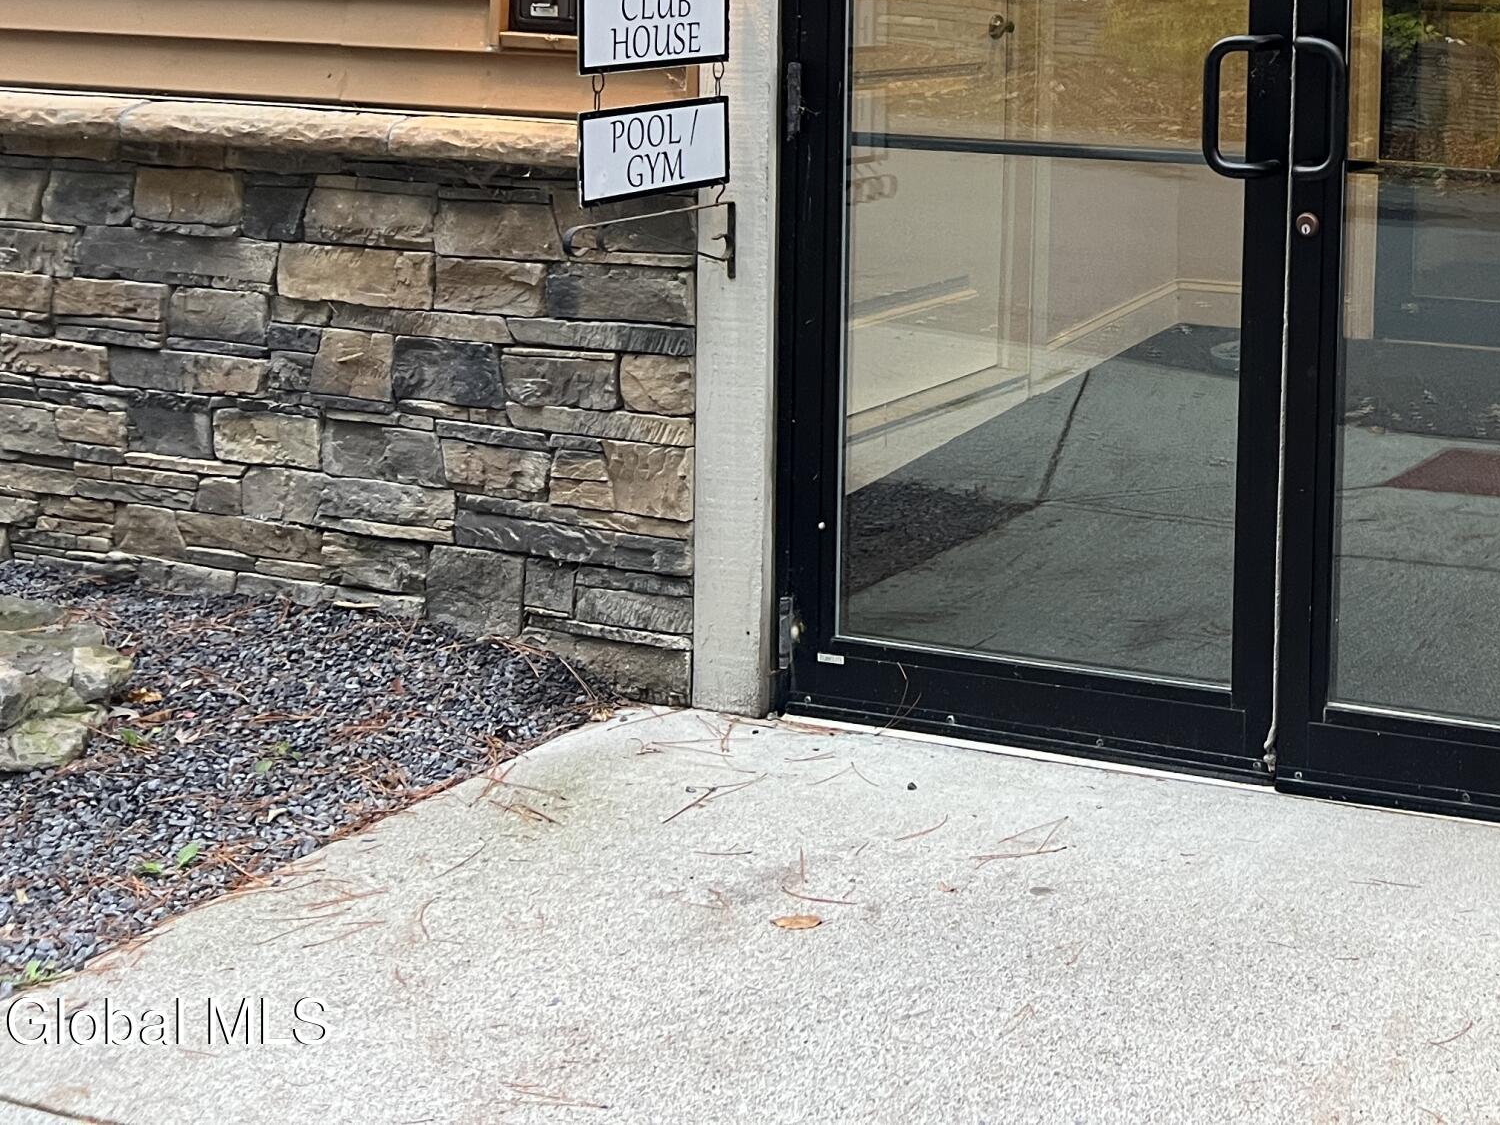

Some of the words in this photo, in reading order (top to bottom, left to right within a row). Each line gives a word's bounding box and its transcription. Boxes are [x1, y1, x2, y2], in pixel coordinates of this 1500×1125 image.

[611, 22, 702, 60] HOUSE
[610, 113, 682, 153] POOL
[689, 109, 699, 147] /
[626, 148, 685, 188] GYM
